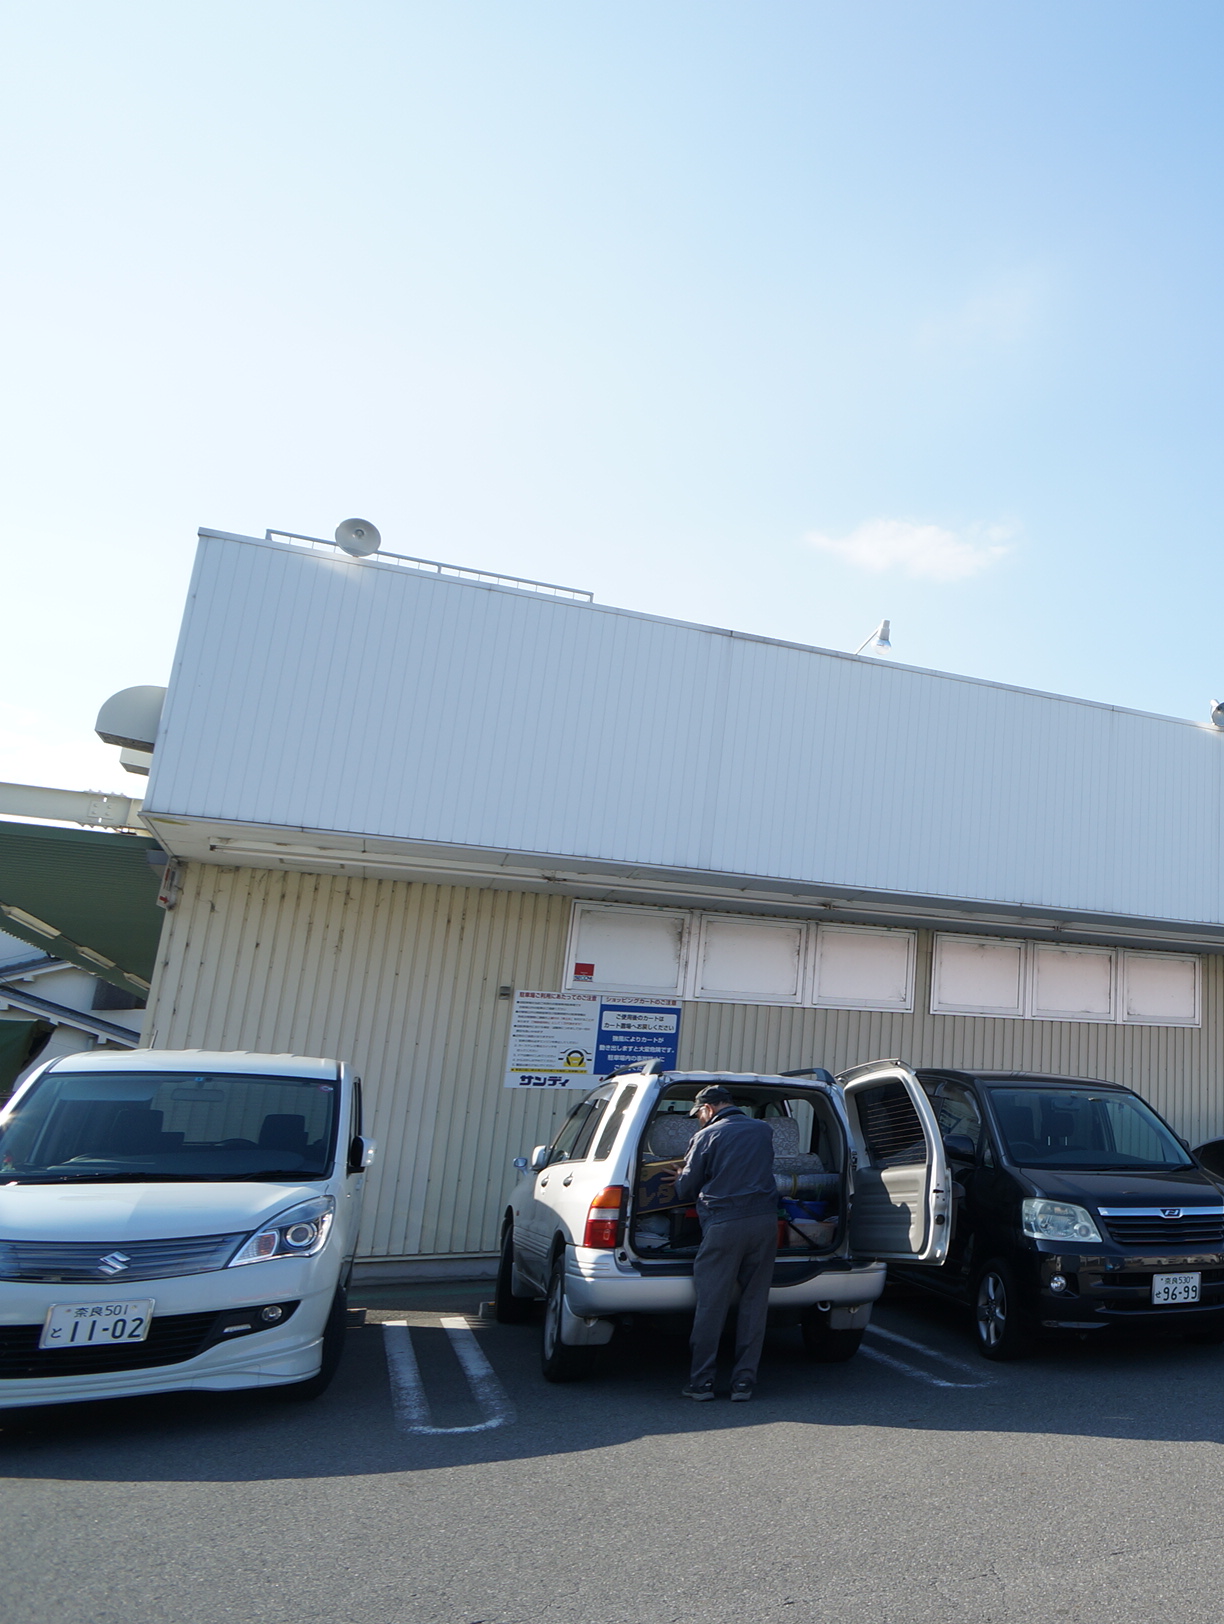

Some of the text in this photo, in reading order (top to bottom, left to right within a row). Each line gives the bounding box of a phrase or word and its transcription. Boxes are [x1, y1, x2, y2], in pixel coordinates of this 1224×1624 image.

[615, 1013, 665, 1022] ご使用後のカートは
[519, 1075, 570, 1087] サンディ
[1163, 1285, 1198, 1301] 96-99
[50, 1317, 144, 1342] と 11-02
